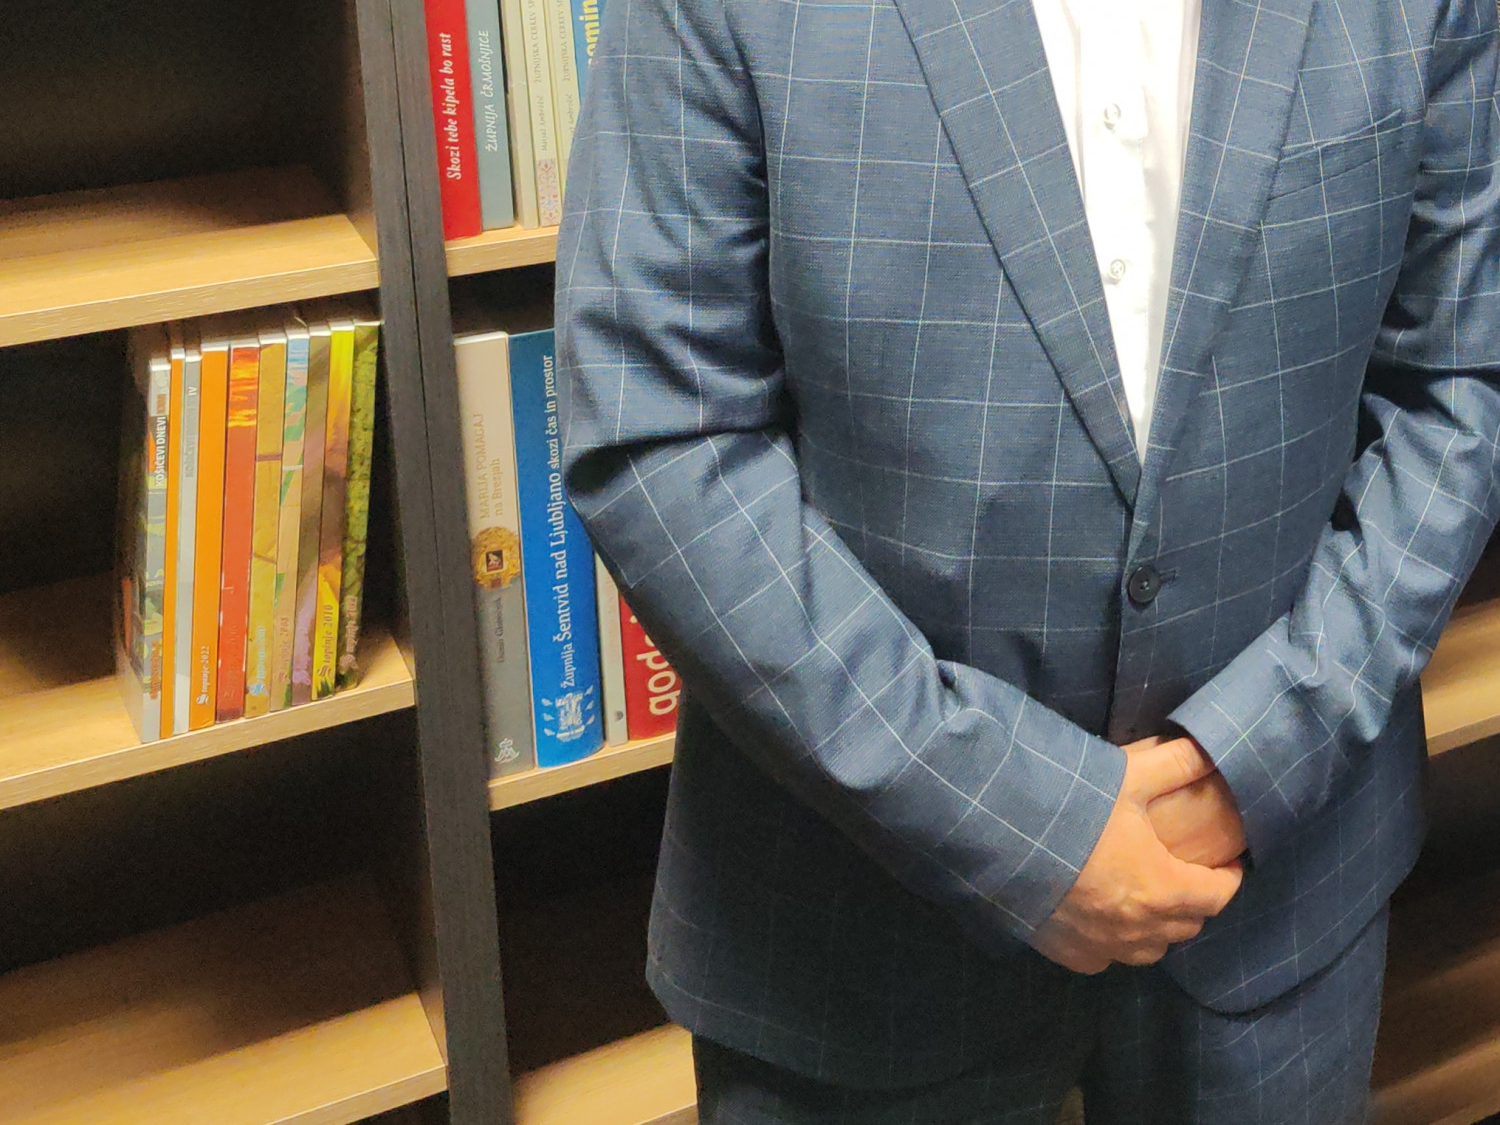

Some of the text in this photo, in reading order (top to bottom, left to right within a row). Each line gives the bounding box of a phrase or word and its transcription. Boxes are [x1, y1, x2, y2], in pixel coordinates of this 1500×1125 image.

[438, 32, 462, 180] Skozi tebe kipela bo rast
[478, 30, 498, 152] ŽUPNIJA ČRMOŠNJICE
[188, 386, 197, 396] IV
[156, 416, 166, 444] DNEVI
[153, 445, 165, 487] KOŠIČEVI
[477, 473, 490, 520] MARIJA
[543, 355, 576, 688] Župnija Šentvid nad Ljubljano skozi čas in prostor
[322, 604, 334, 627] 2010
